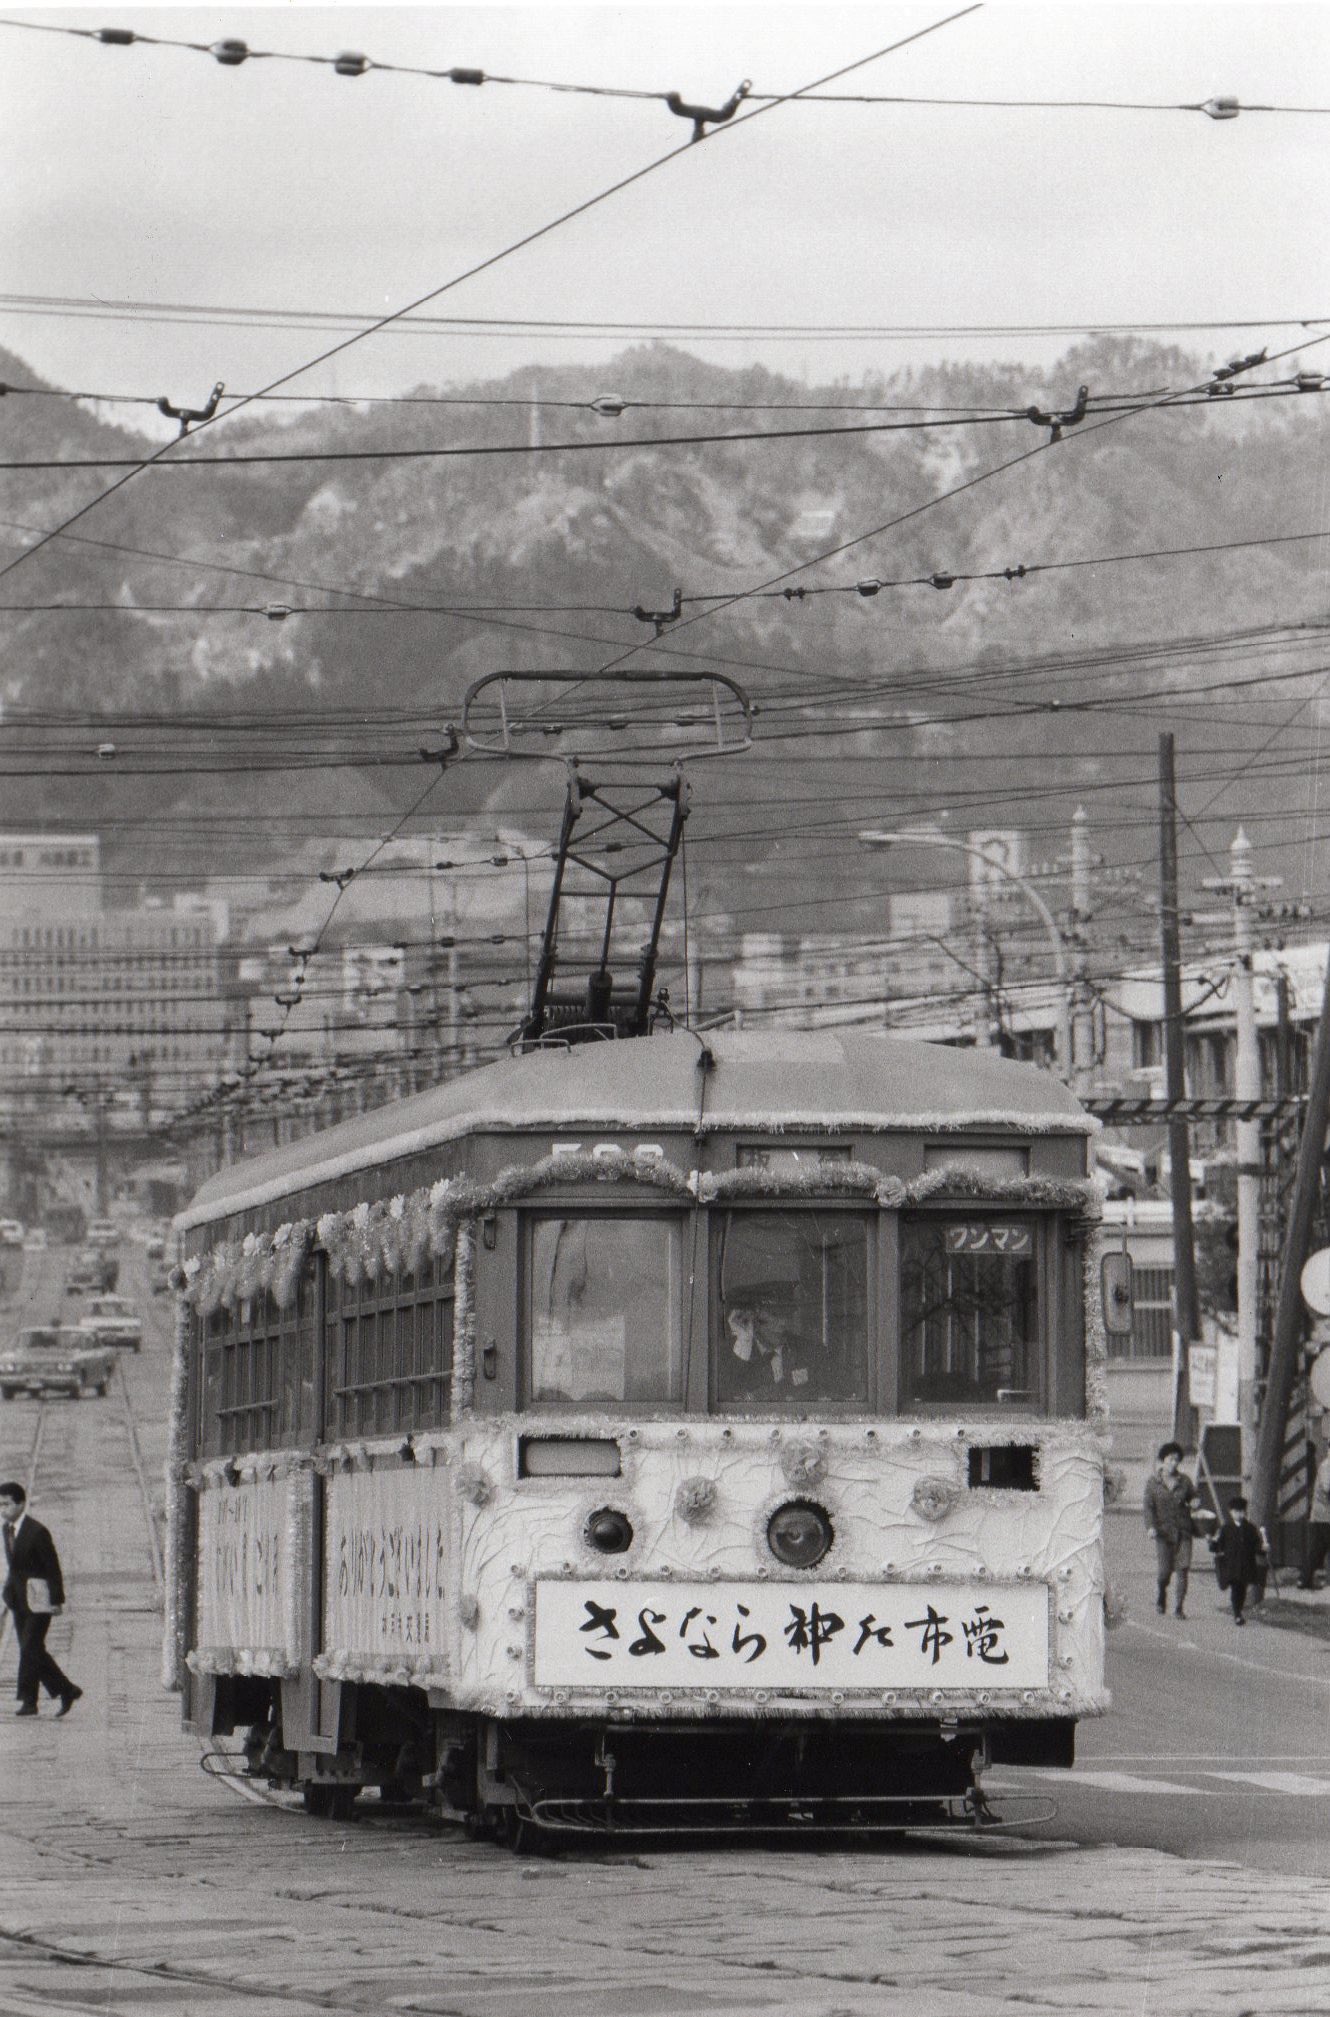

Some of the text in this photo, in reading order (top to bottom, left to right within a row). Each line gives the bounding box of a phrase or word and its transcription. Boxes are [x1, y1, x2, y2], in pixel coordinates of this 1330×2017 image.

[949, 1227, 1029, 1251] ワンマン
[577, 1600, 1009, 1665] さよなら神戸市電
